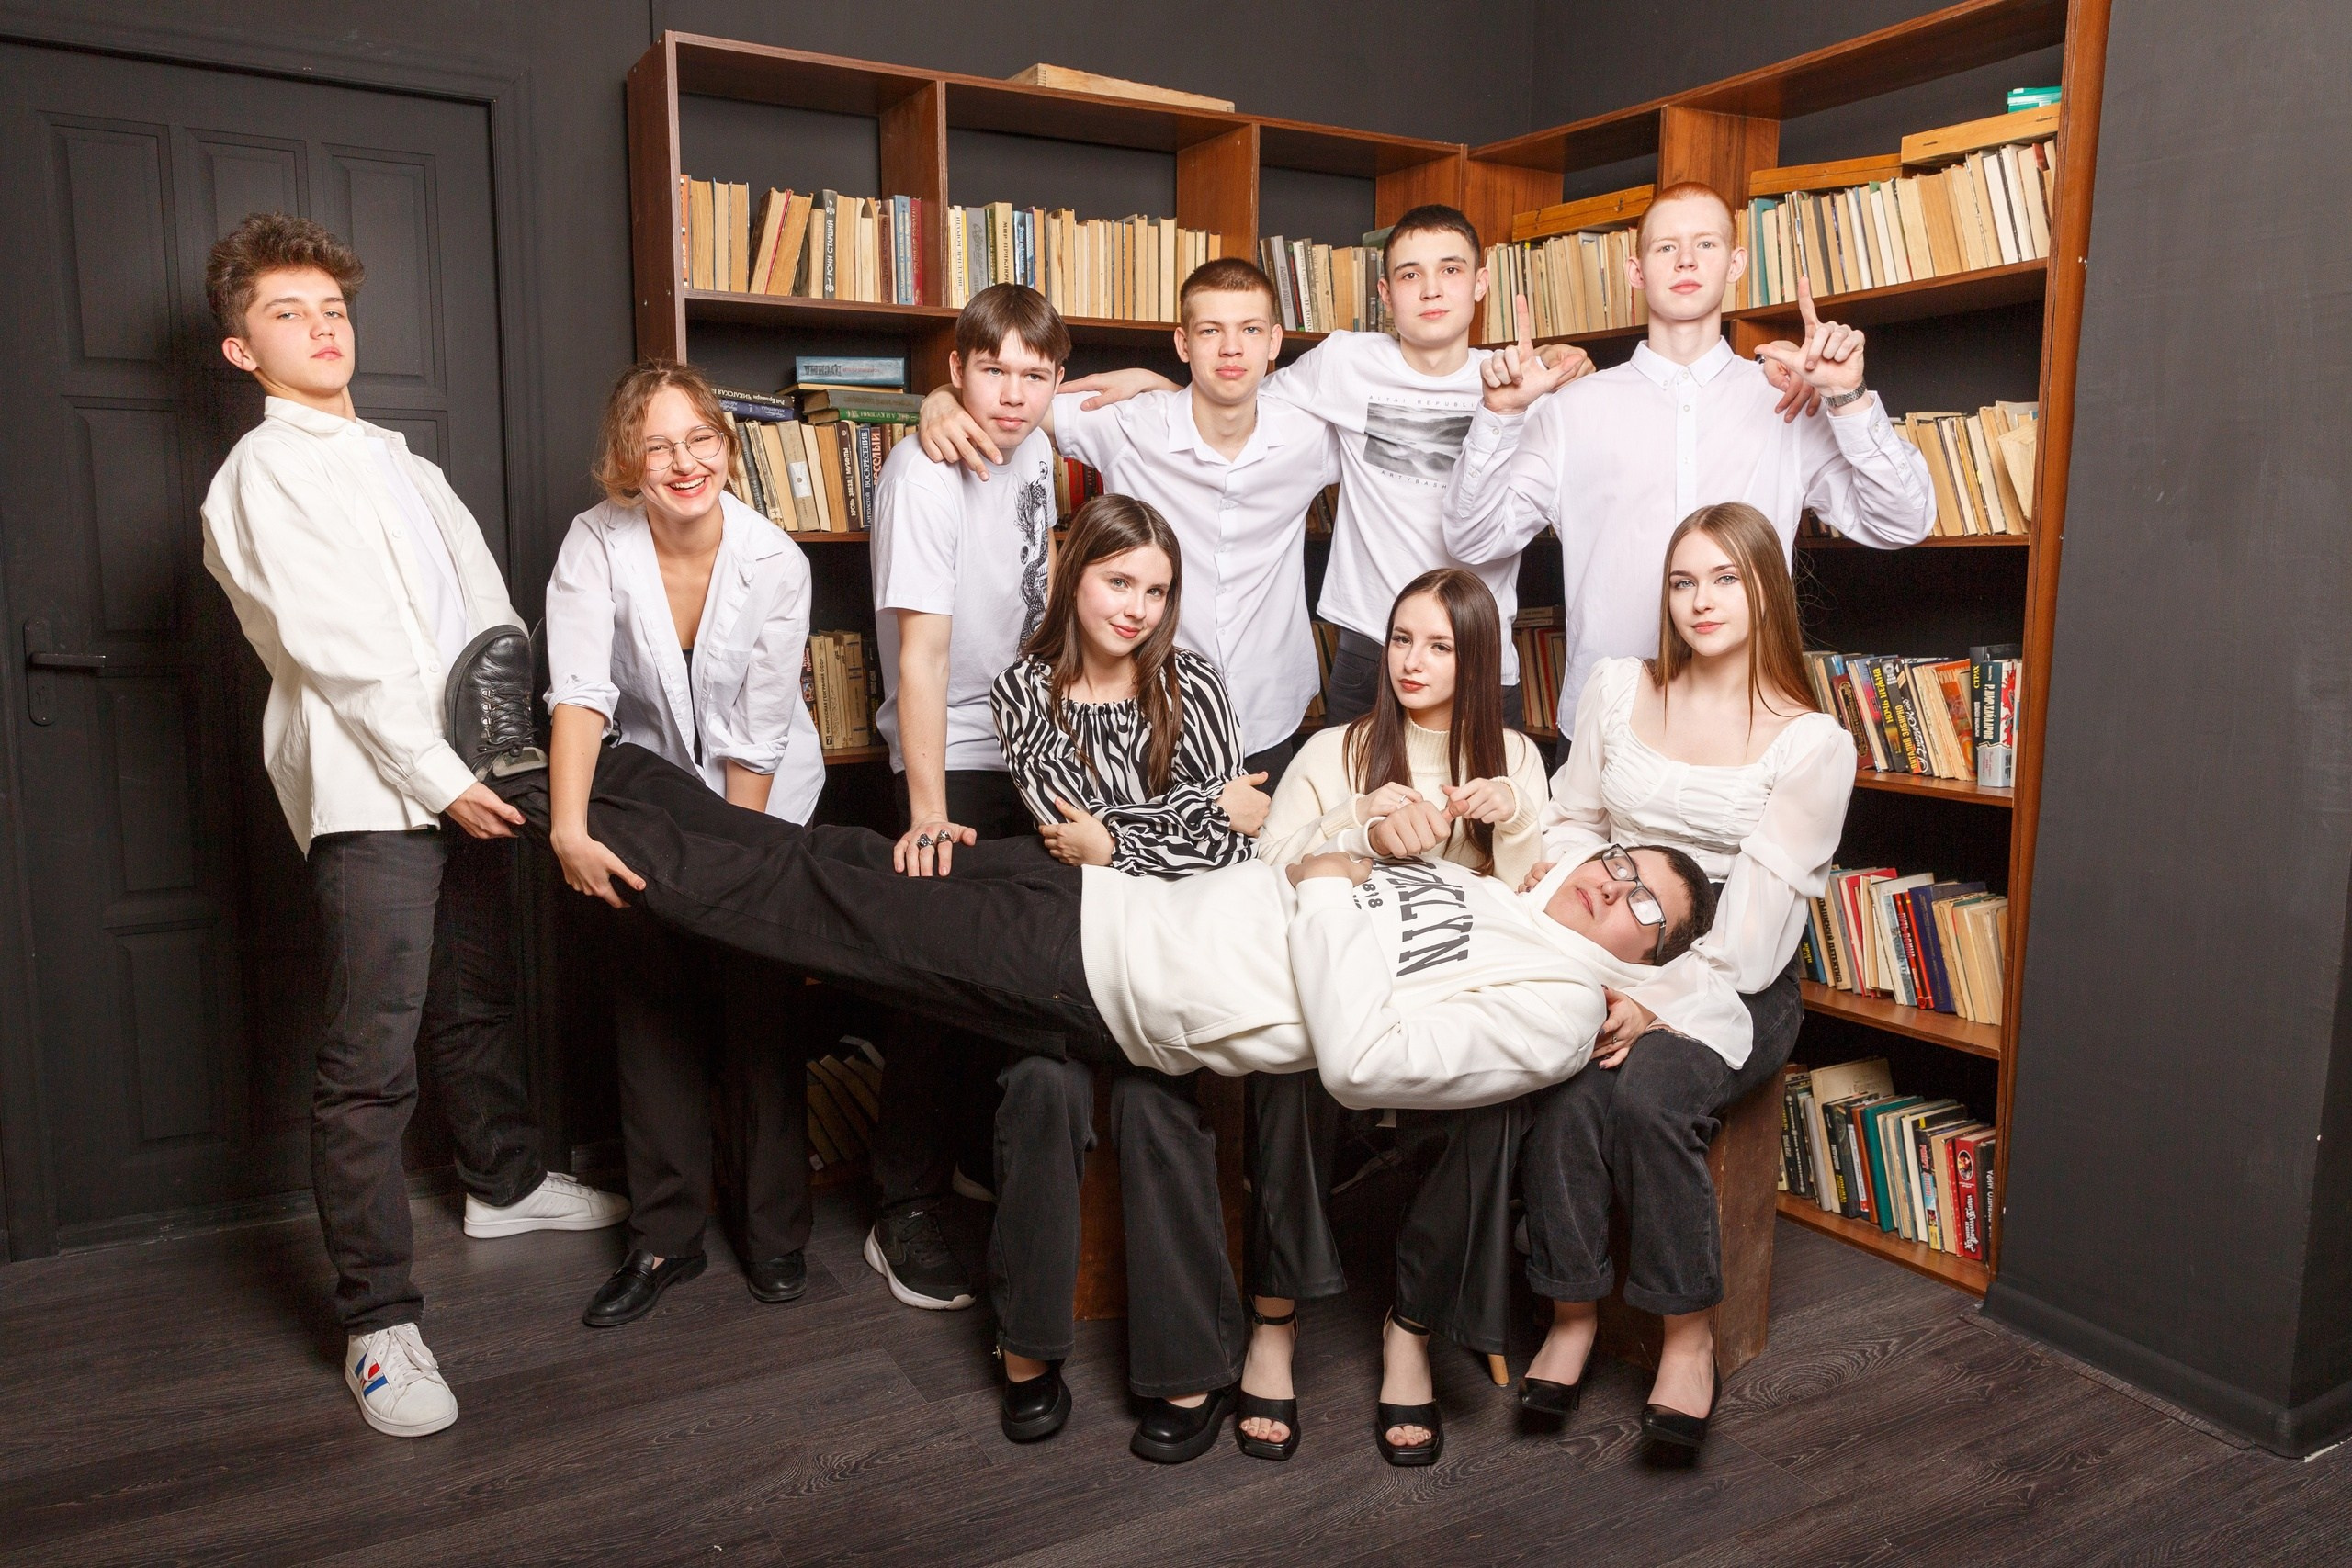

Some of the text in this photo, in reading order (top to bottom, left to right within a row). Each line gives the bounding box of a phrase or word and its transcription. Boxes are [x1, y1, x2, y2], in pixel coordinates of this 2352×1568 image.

[1368, 395, 1475, 408] ALTAI REPUBLI
[842, 447, 852, 475] МУТАНТЫ
[861, 432, 870, 488] ВОСКРЕСЕНИЕ
[1381, 470, 1447, 489] ARTYBASH
[1873, 668, 1887, 698] НЕЖНА
[1882, 699, 1894, 724] НОЧЬ
[1895, 705, 1910, 737] ЗАБИРКО
[1903, 738, 1918, 769] ВИТАЛИЙ
[1818, 897, 1833, 941] ТЫШСКИЙ
[1898, 912, 1916, 958] ПУТЬ ВОИНА
